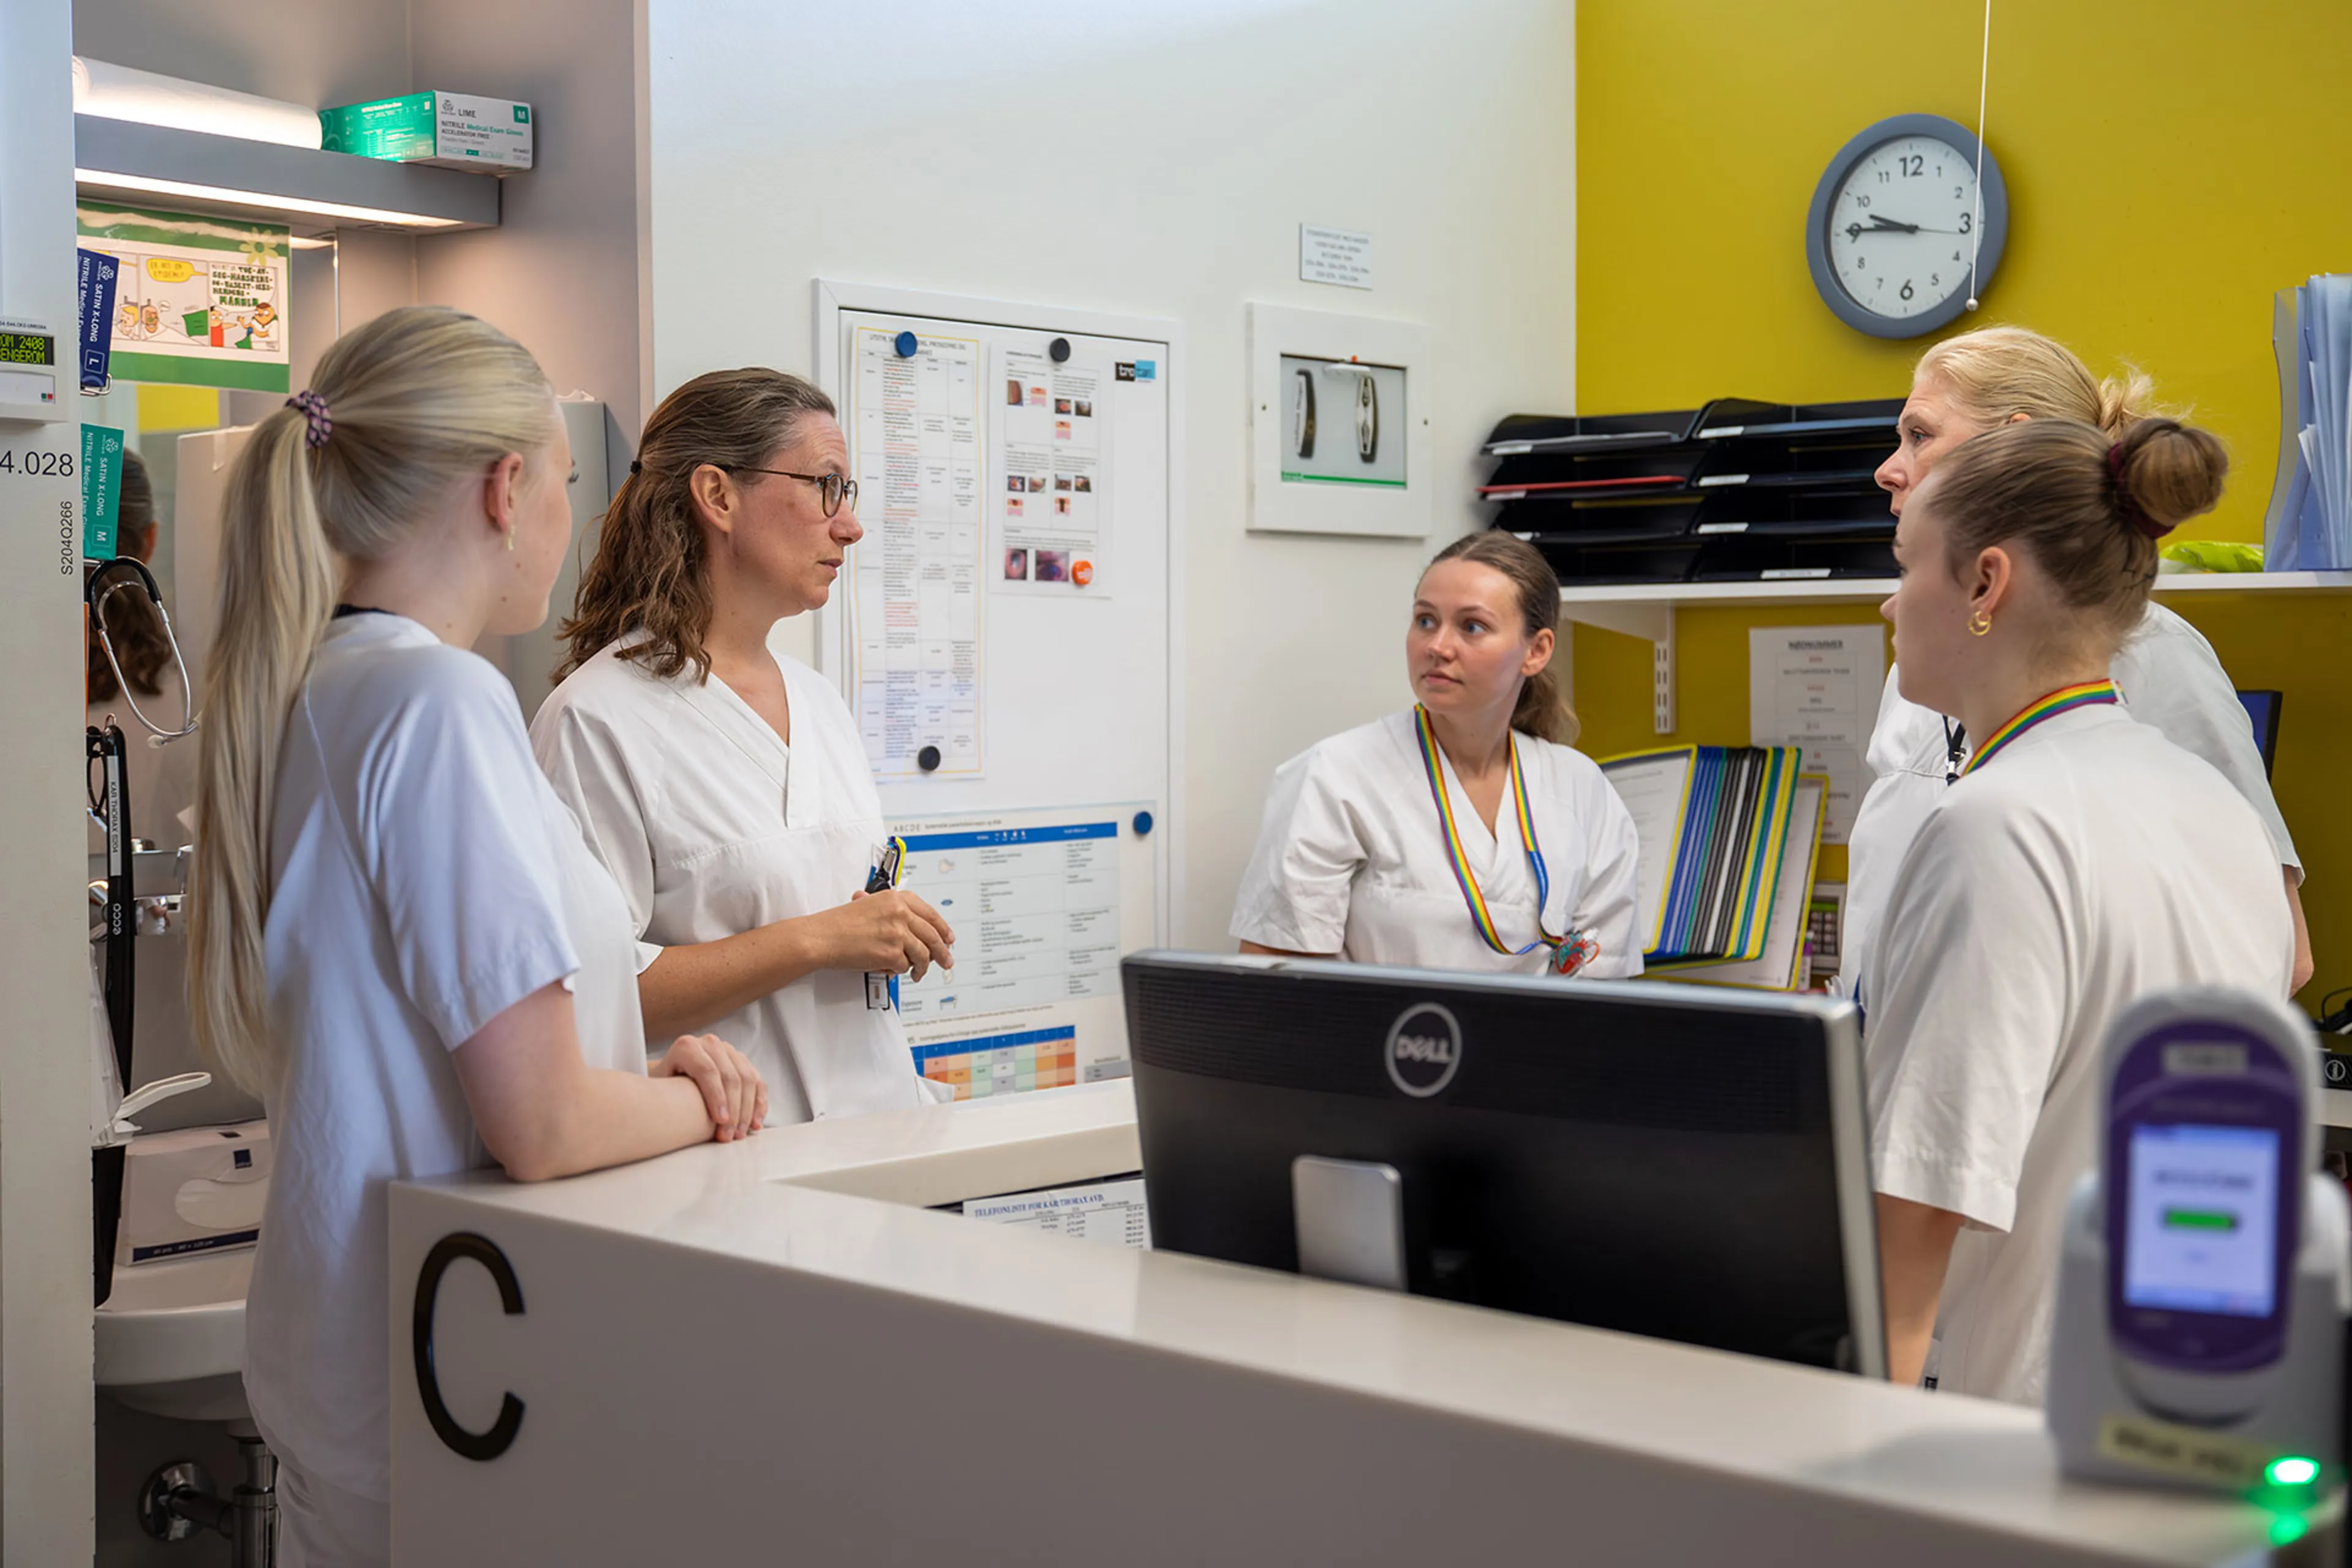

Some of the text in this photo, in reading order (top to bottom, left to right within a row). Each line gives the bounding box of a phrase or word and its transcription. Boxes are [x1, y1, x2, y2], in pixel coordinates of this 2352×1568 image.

[458, 109, 477, 119] LIME
[441, 120, 465, 129] NITRILE
[467, 123, 488, 132] Medical
[441, 128, 476, 137] ACCELERATOR
[1878, 170, 1890, 183] 11
[1899, 154, 1924, 178] 12
[1936, 165, 1942, 178] 1
[1856, 194, 1871, 208] 10
[1954, 186, 1963, 199] 2
[1959, 212, 1971, 234] 3
[1857, 256, 1865, 270] 8
[1952, 250, 1960, 262] 4
[81, 257, 91, 288] NITRILE
[1876, 277, 1883, 290] 7
[1931, 273, 1939, 286] 5
[92, 283, 104, 309] SATIN
[1899, 279, 1914, 301] 6
[89, 310, 101, 343] X-LONG
[84, 431, 94, 463] NITRILE
[0, 450, 74, 477] 4.028
[99, 457, 108, 483] SATIN
[83, 465, 91, 494] Medical
[96, 484, 107, 516] X-LONG
[60, 500, 74, 576] S204Q266
[96, 531, 107, 542] M
[112, 903, 123, 936] ecco
[1395, 1034, 1454, 1065] DELL
[974, 1202, 1027, 1218] TELEFONLISTE
[1028, 1202, 1041, 1211] FOR
[1060, 1196, 1088, 1208] THORAX
[413, 1231, 526, 1461] C
